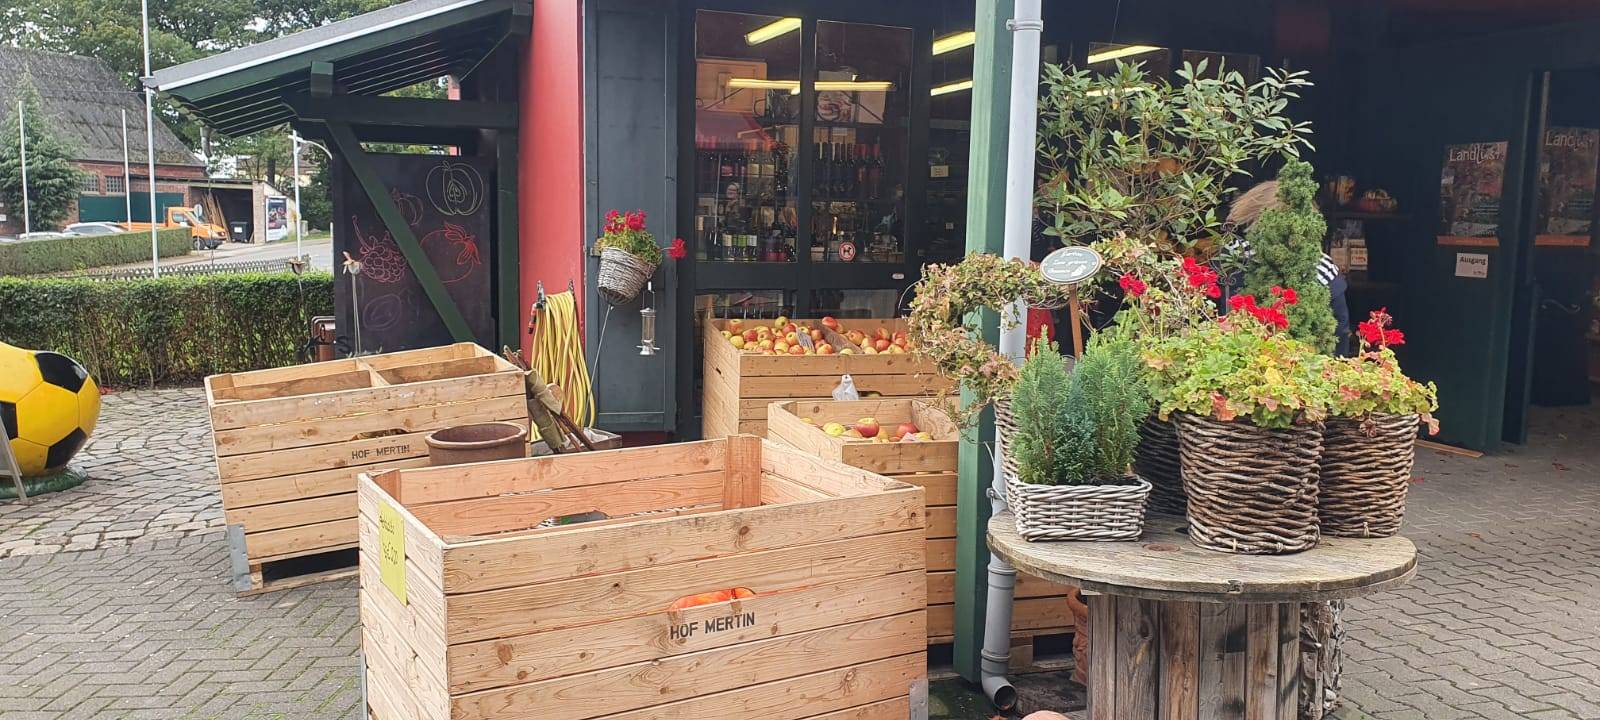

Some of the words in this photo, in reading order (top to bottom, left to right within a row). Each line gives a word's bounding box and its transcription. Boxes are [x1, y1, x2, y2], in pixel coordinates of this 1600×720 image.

[351, 450, 370, 459] HOF
[376, 444, 410, 456] MERTIN
[670, 621, 698, 639] HOF
[705, 612, 755, 634] MERTIN
